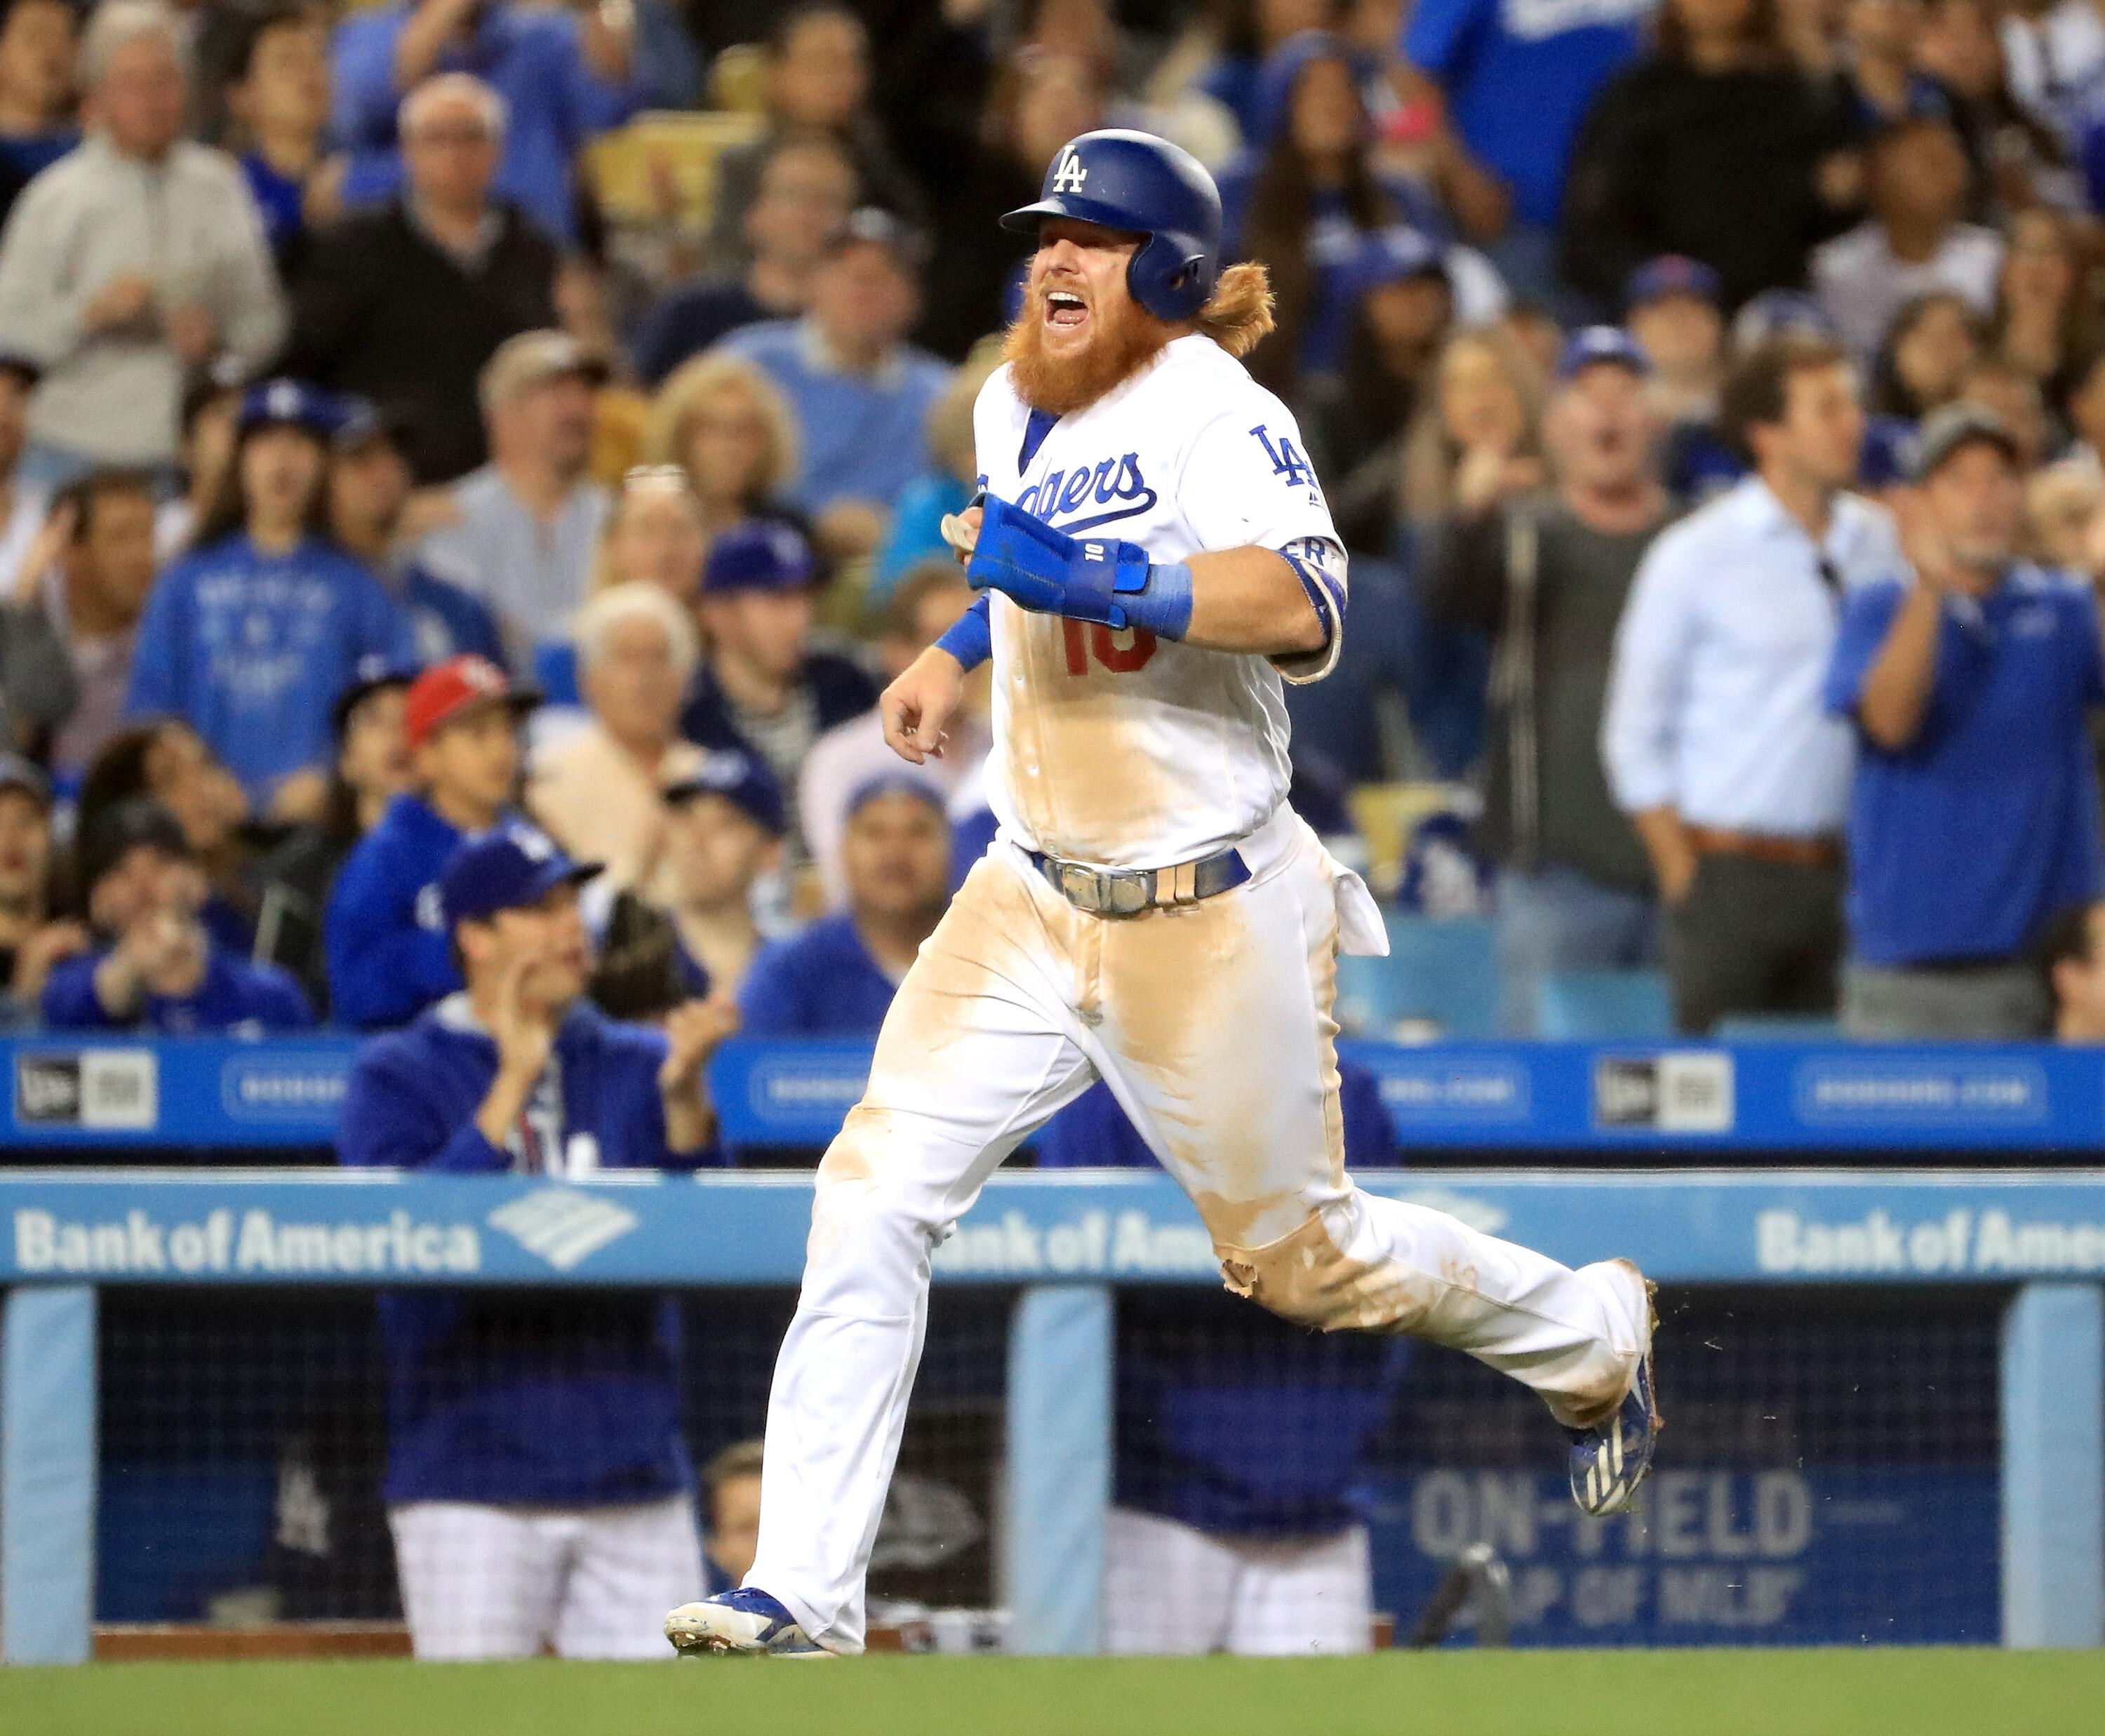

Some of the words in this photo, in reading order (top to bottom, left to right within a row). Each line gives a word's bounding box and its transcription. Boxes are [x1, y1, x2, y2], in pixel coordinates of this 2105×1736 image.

[1052, 145, 1088, 193] LA
[977, 451, 1147, 526] dgers
[1249, 424, 1319, 490] LA
[1085, 542, 1104, 561] 10
[14, 1208, 166, 1272] Bank
[168, 1208, 233, 1272] of
[234, 1208, 481, 1272] America
[933, 1210, 1041, 1271] ank
[1048, 1210, 1110, 1272] of
[1113, 1210, 1217, 1271] Am
[1756, 1208, 1904, 1273] Bank
[1908, 1208, 1972, 1273] of
